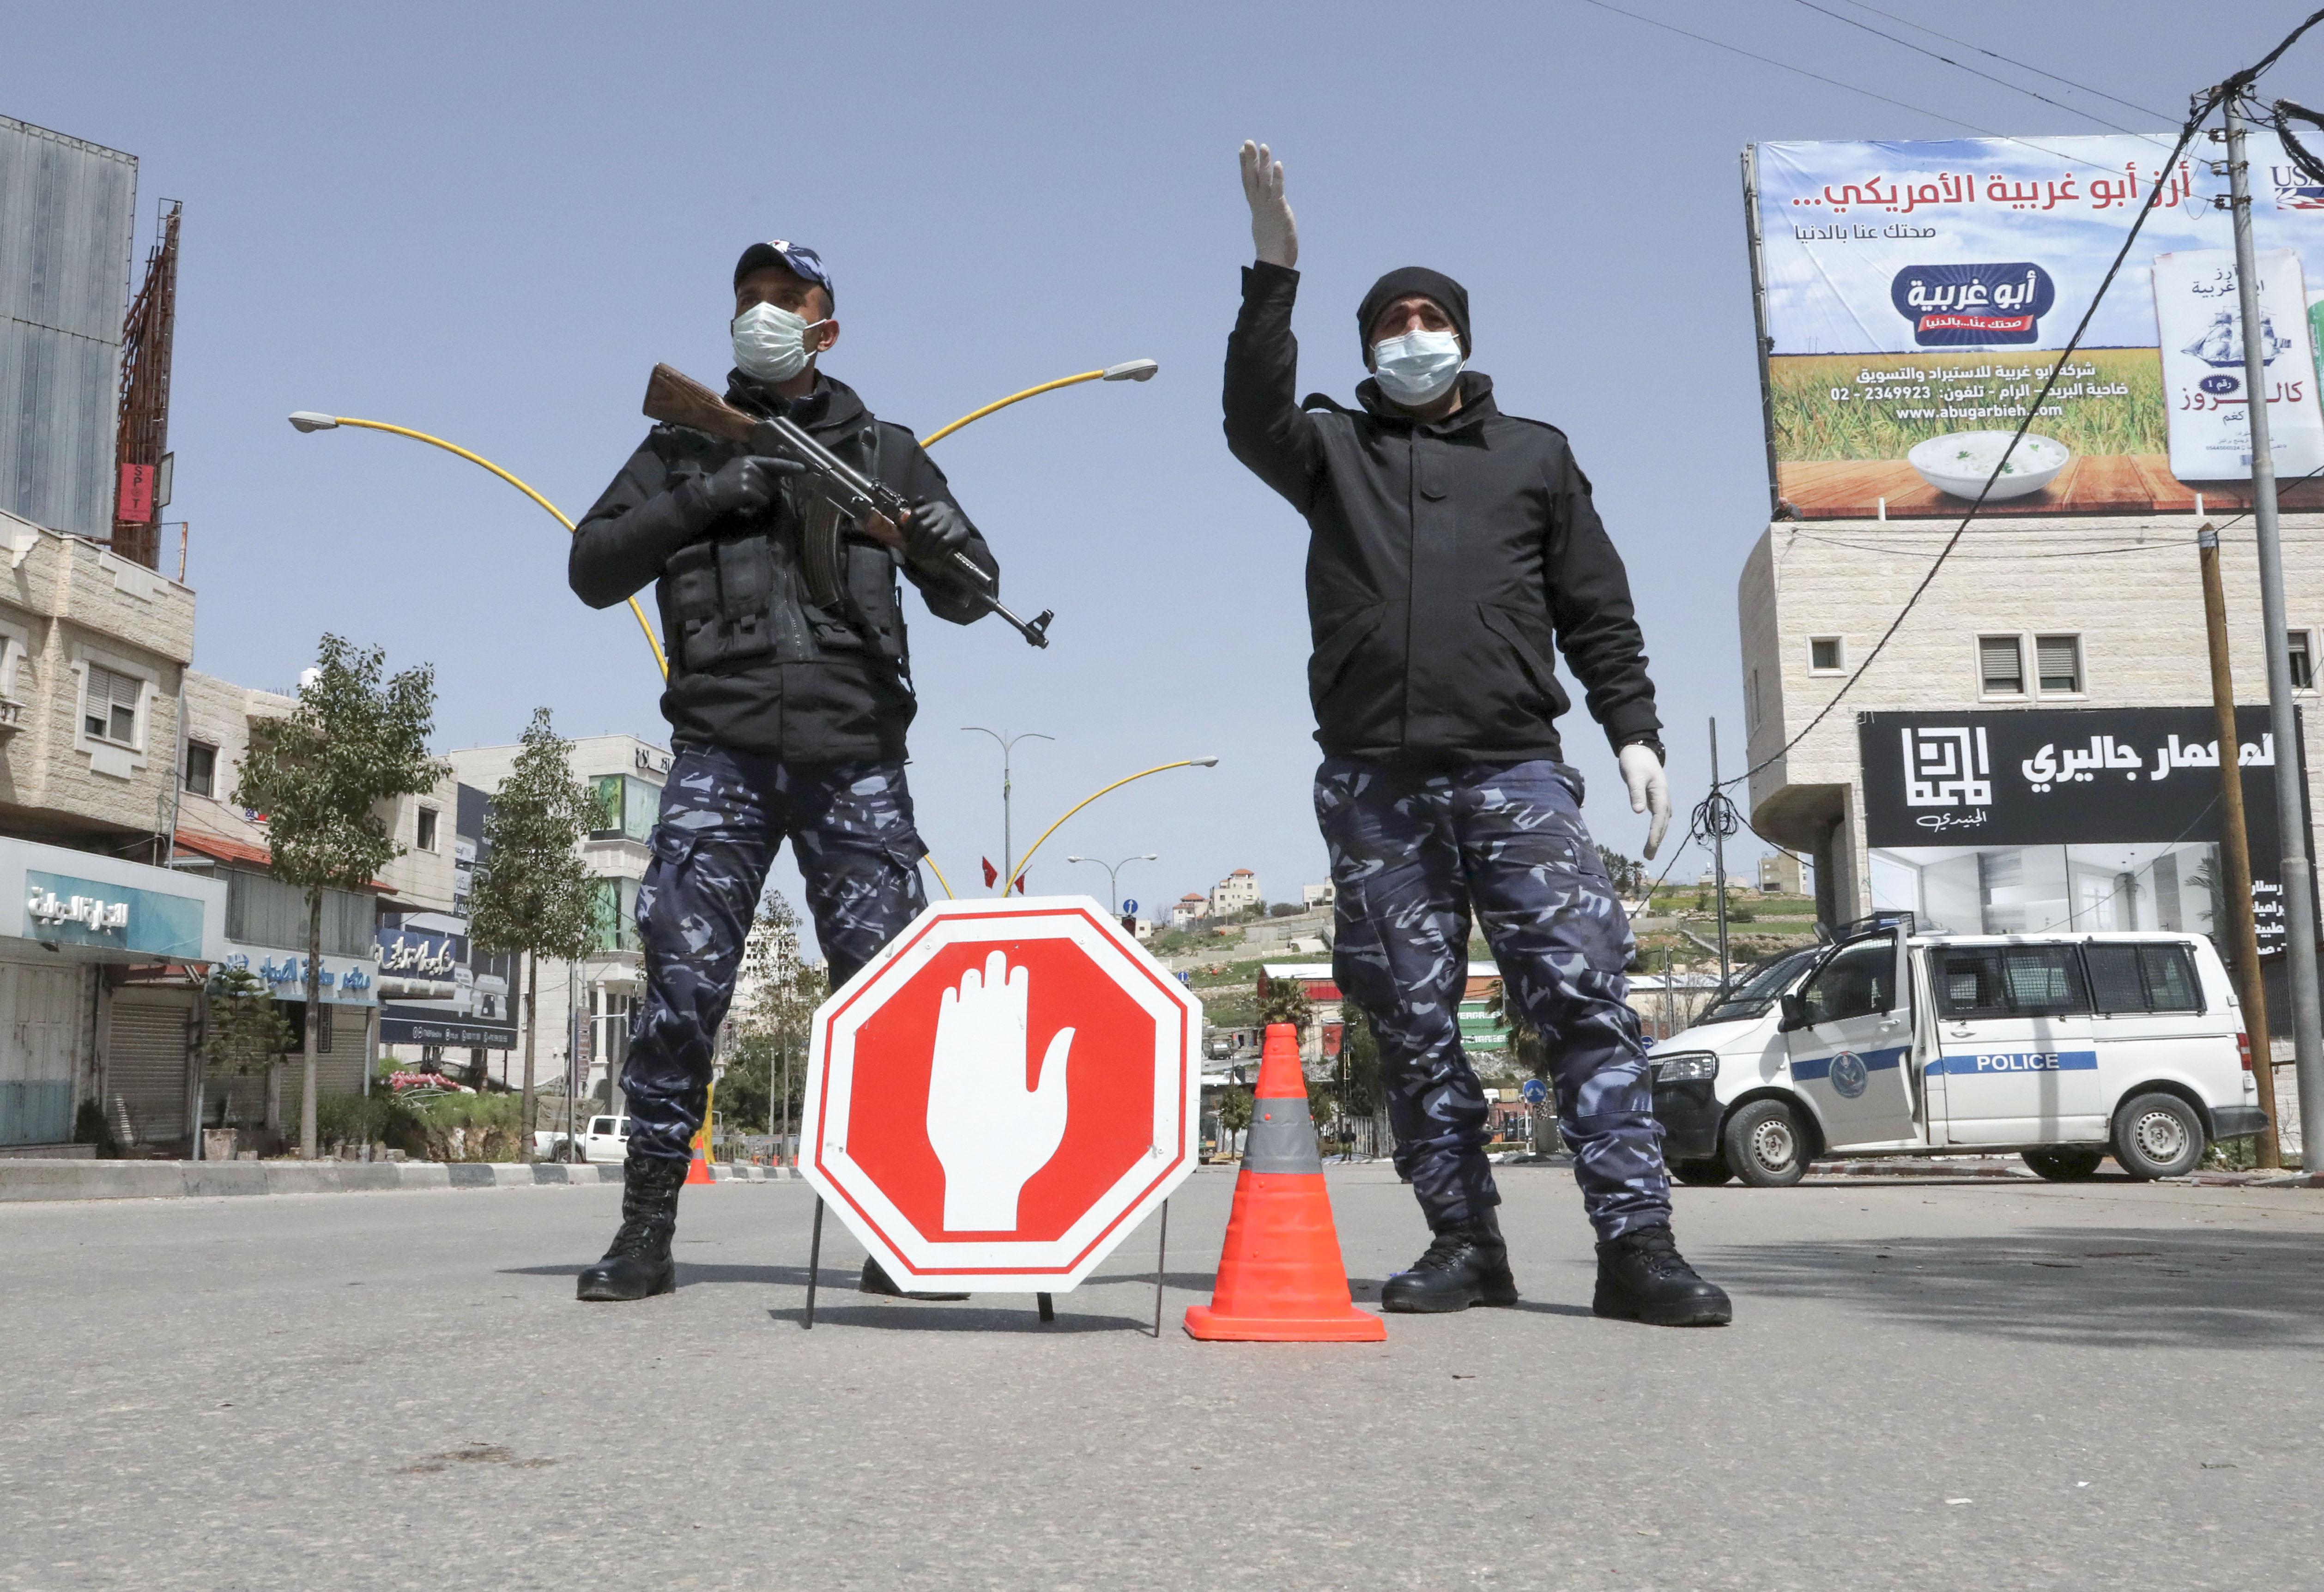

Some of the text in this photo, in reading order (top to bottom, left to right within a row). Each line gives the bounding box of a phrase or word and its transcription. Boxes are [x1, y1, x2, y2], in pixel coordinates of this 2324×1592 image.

[2270, 165, 2314, 187] US
[1987, 173, 2079, 210] غربية
[2090, 162, 2137, 209] أبو
[1795, 224, 1937, 243] صحتك عنا بالدنيا
[1907, 270, 2036, 311] أبو غربية
[2192, 281, 2236, 298] غربية
[1987, 320, 2022, 329] صحتك
[1856, 368, 1925, 384] والتسويق
[1929, 365, 1991, 382] للاستيراد
[1995, 365, 2031, 381] غربية
[2058, 362, 2096, 379] شركة
[1830, 388, 1850, 400] 02
[1865, 386, 1931, 400] 2349923
[1999, 384, 2030, 400] الرام
[2046, 383, 2083, 399] البريد
[2086, 382, 2129, 397] ضاحية
[2021, 735, 2142, 794] جاليري
[1977, 1053, 2060, 1071] POLICE
